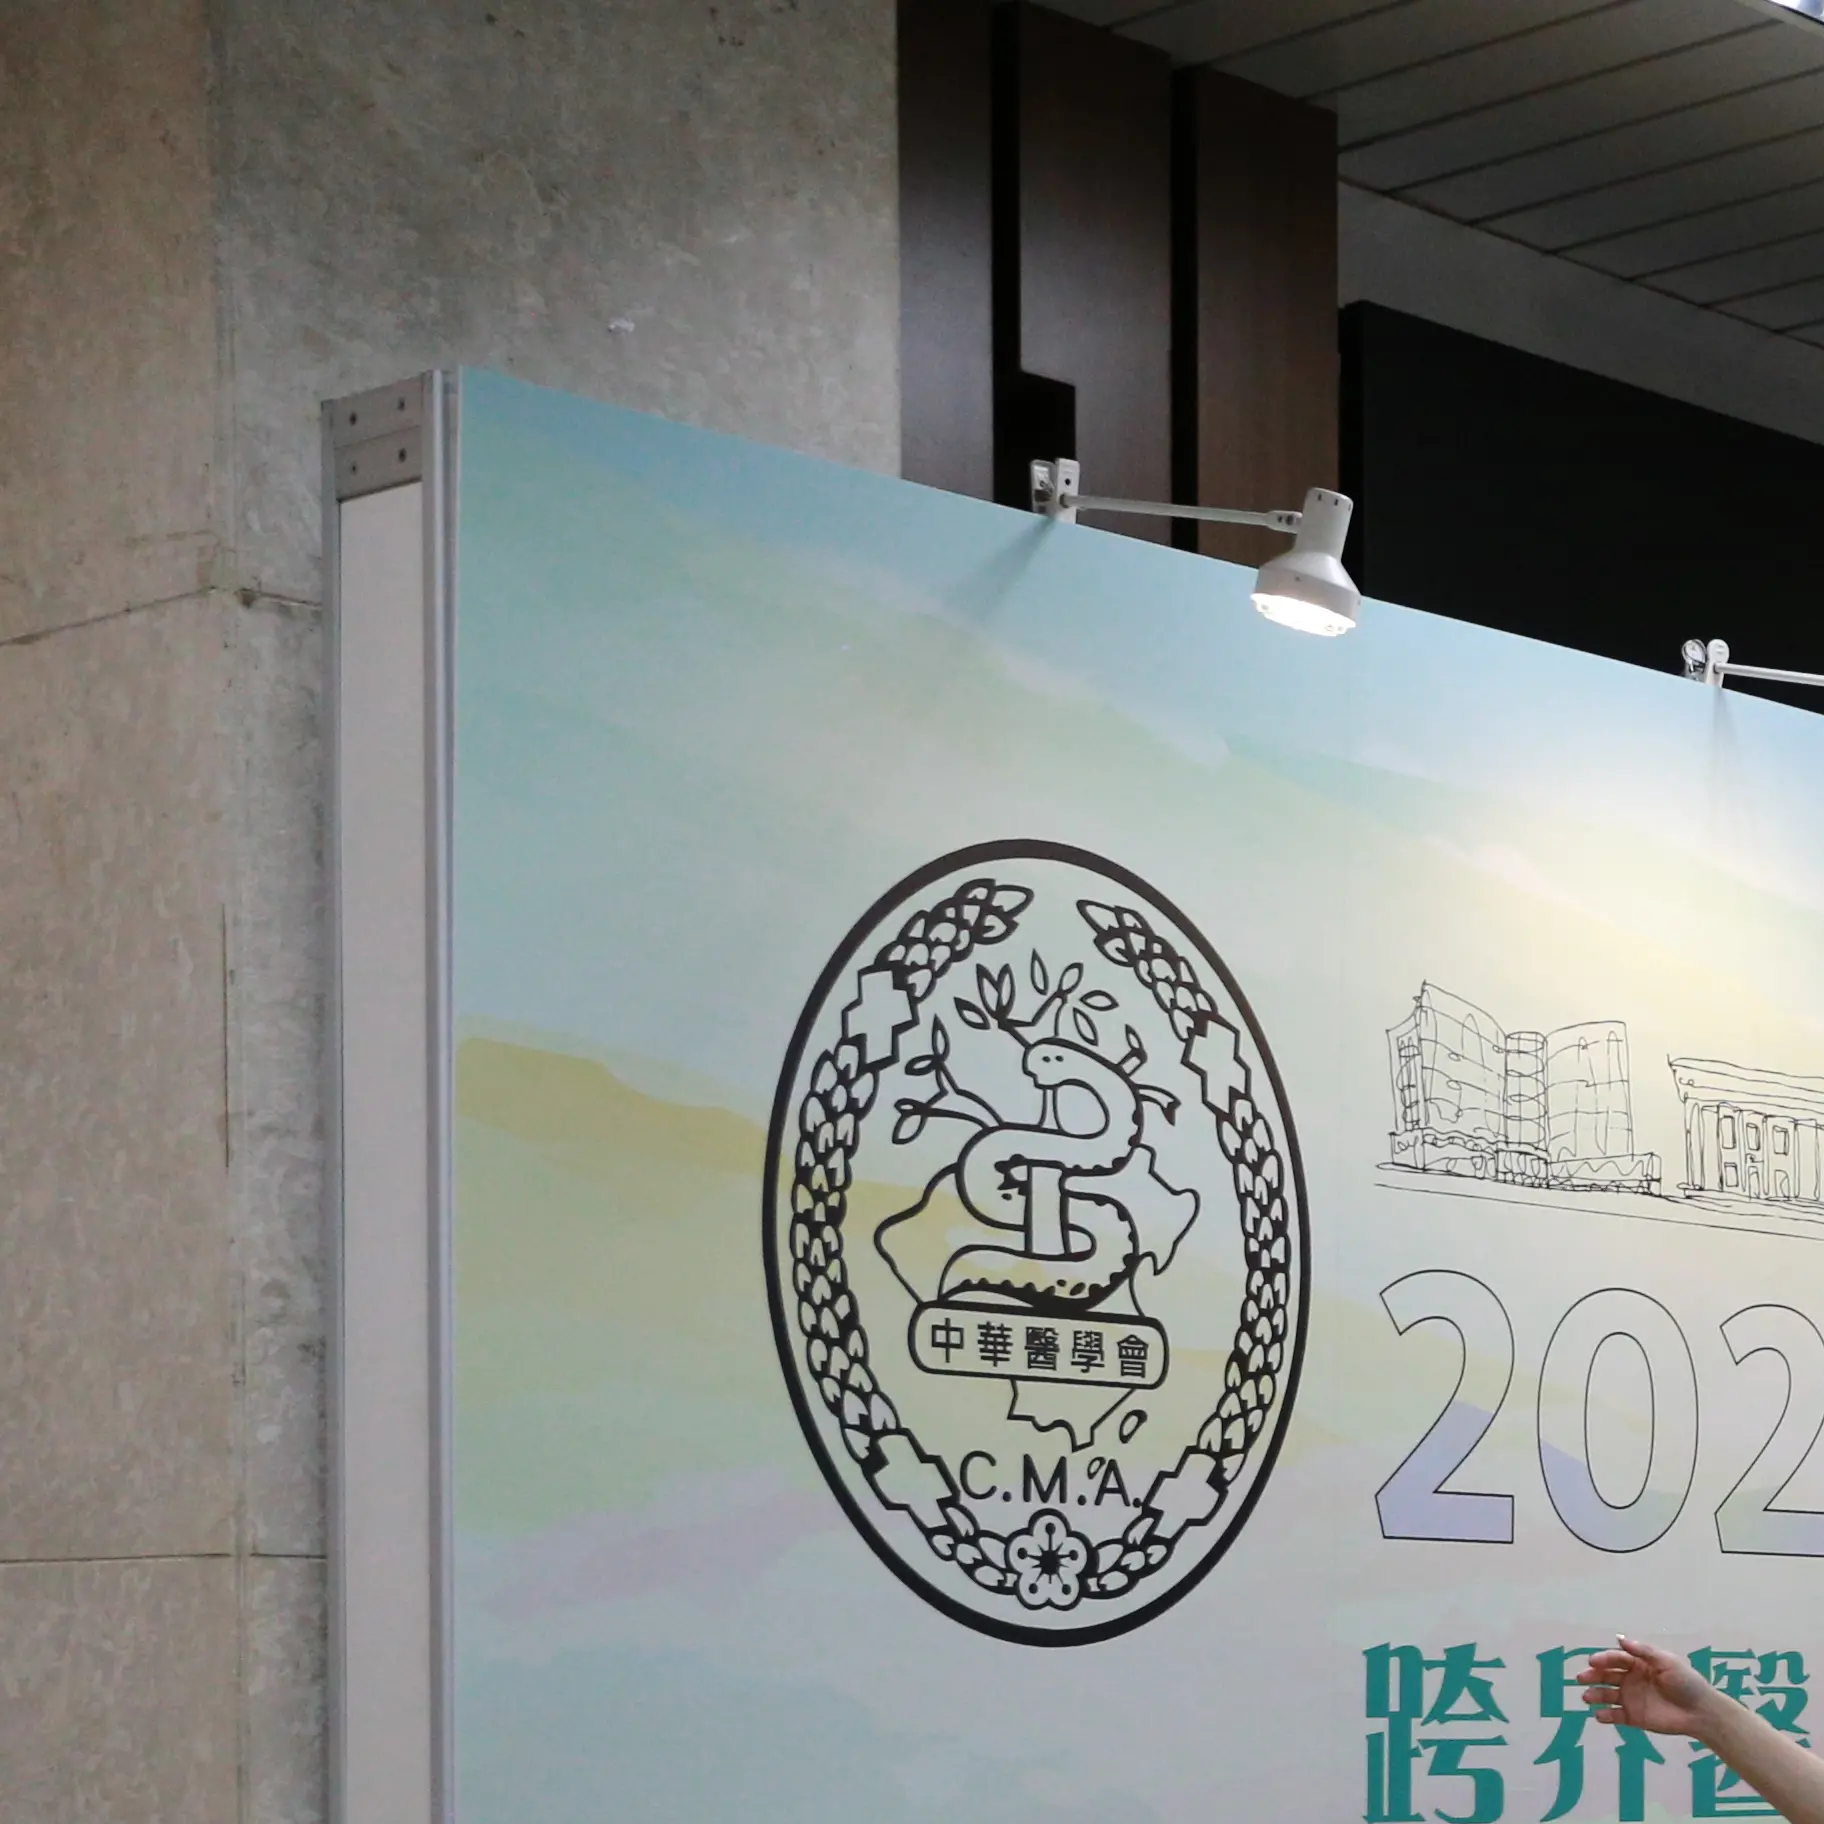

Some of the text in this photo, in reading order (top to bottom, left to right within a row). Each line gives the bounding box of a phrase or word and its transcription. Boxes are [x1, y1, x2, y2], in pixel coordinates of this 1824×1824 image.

[930, 1318, 1152, 1379] 中華醫學會
[959, 1449, 1144, 1508] C.M.A.
